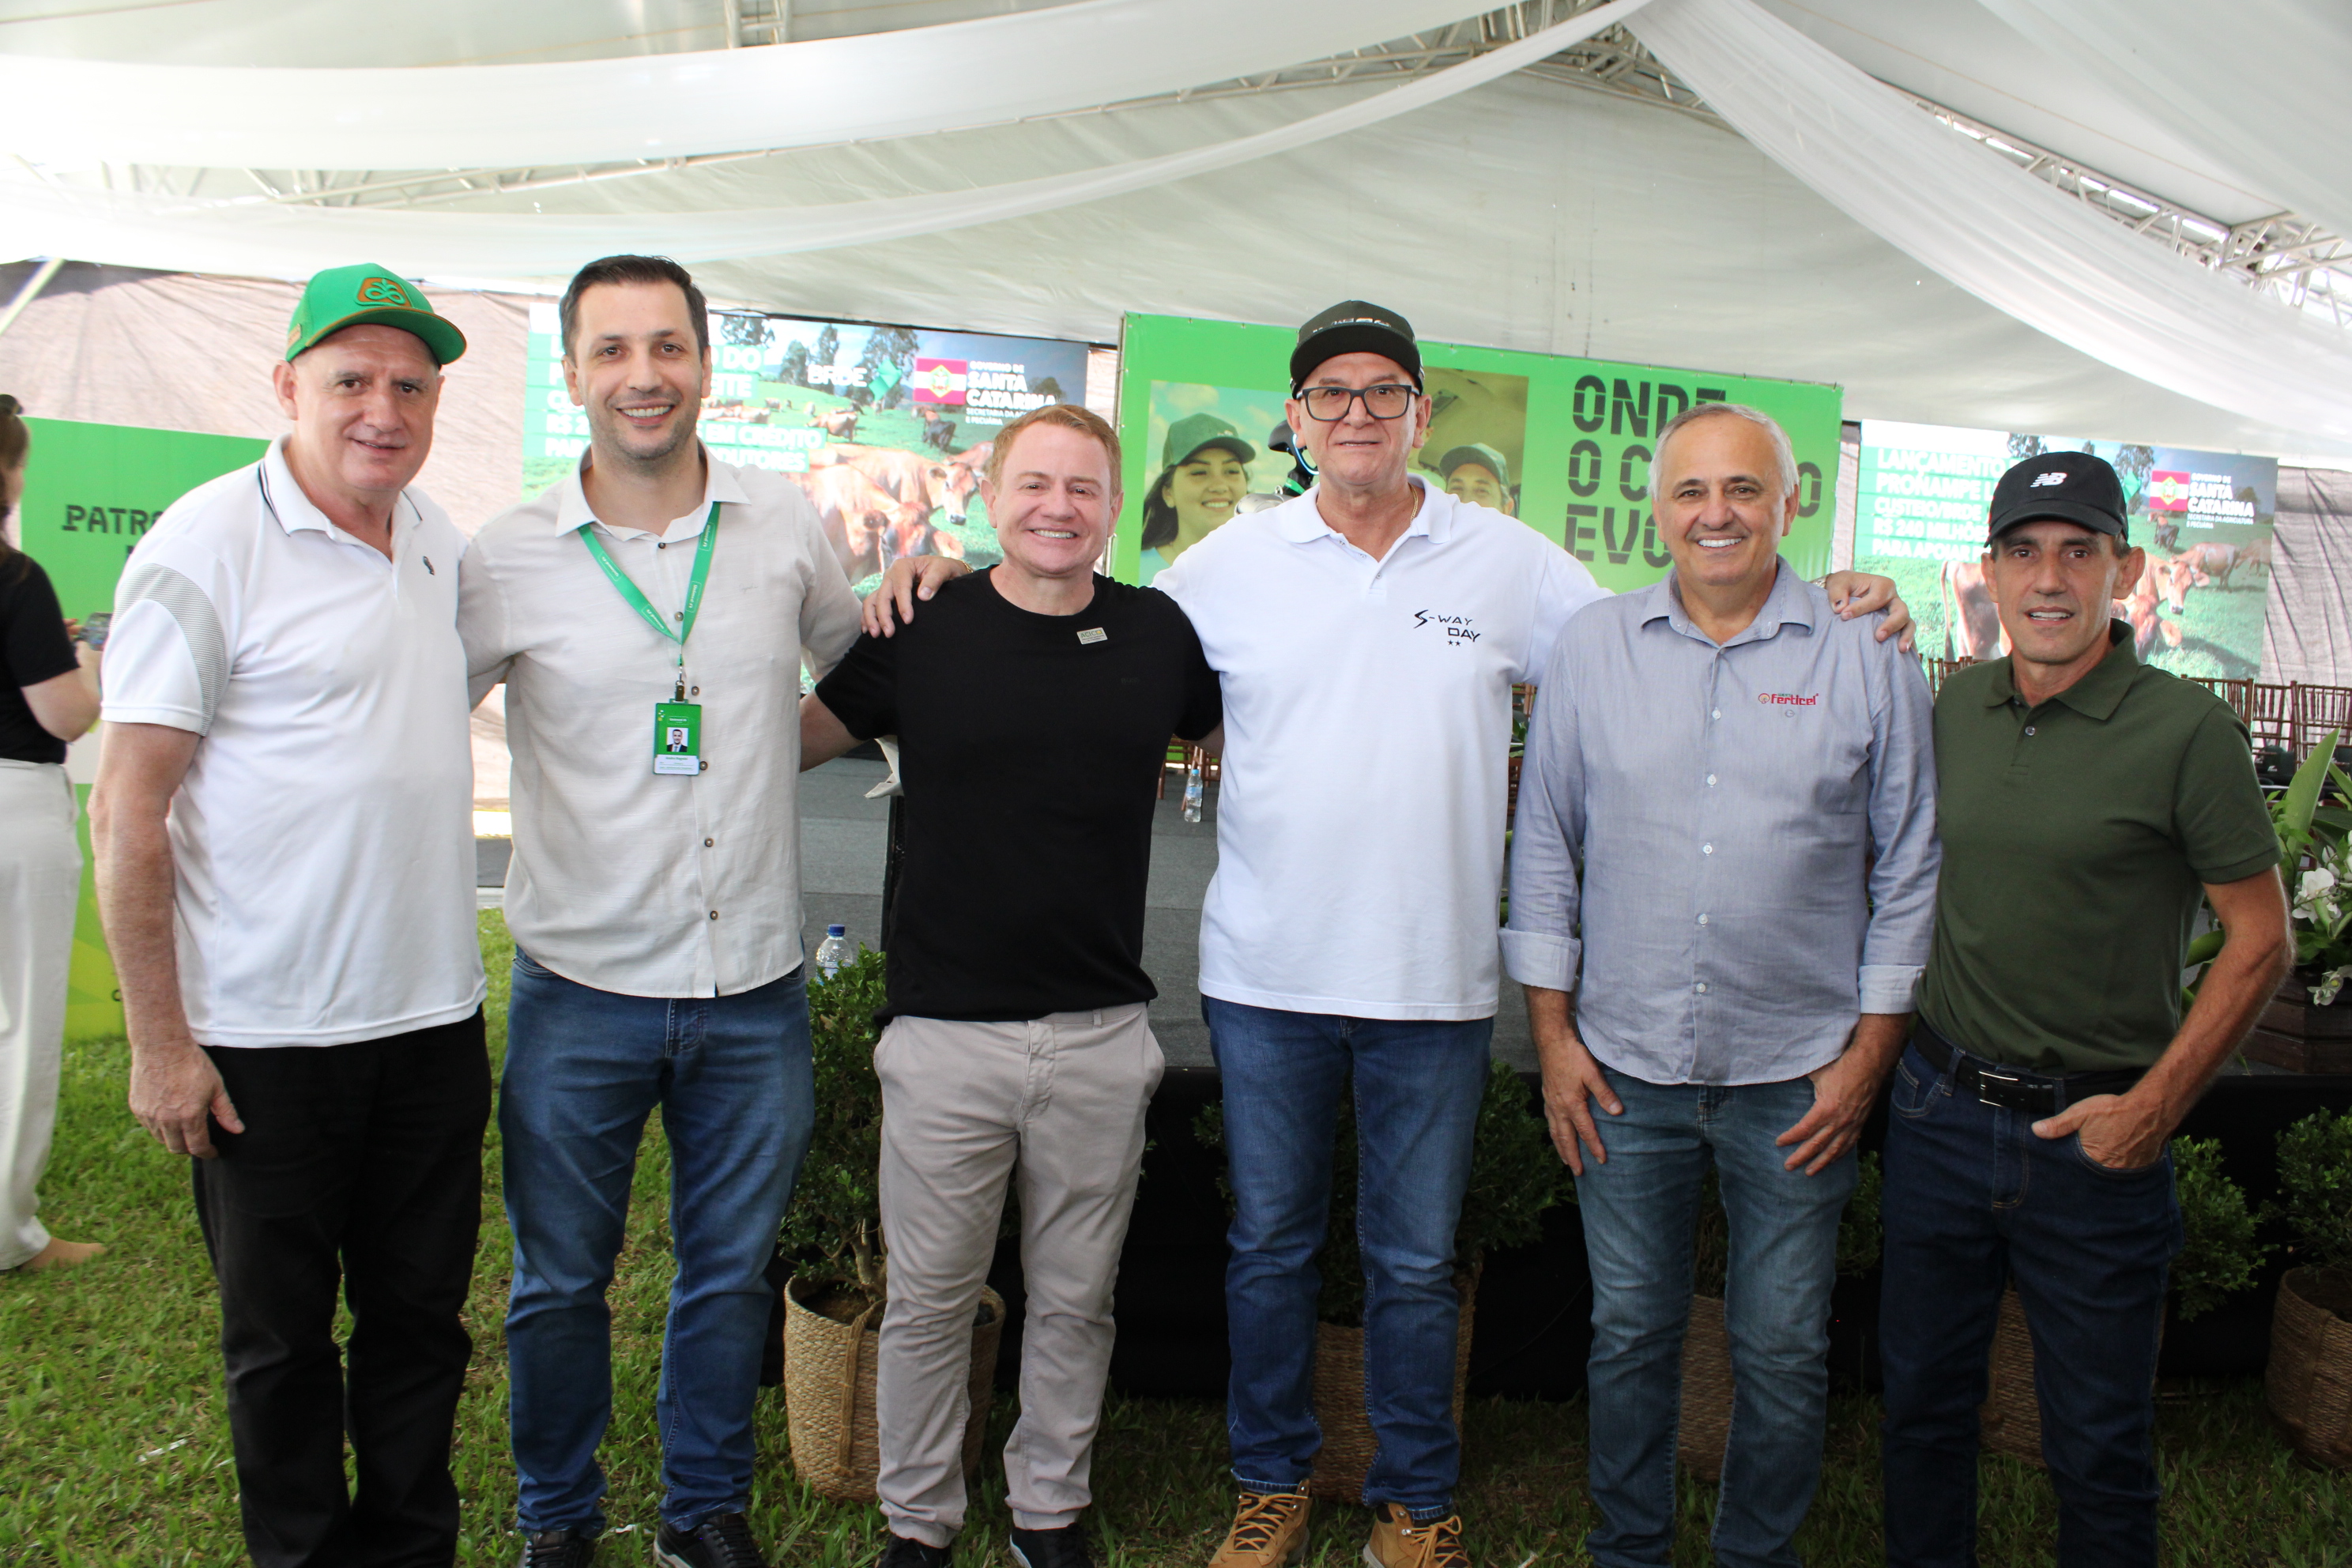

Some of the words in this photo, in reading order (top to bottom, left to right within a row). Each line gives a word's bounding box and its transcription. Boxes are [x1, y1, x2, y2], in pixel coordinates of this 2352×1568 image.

[722, 346, 762, 371] DO
[970, 360, 1012, 373] GOVERNO
[1012, 364, 1025, 374] DE
[807, 364, 868, 387] BRDE
[967, 371, 1028, 392] SANTA
[966, 388, 1057, 410] CATARINA
[1573, 375, 1727, 439] OND
[706, 423, 736, 443] EM
[739, 423, 823, 449] CRÉDITO
[545, 437, 592, 458] PAR
[1568, 439, 1602, 497] O
[1877, 448, 2006, 478] LANÇAMENTO
[1875, 473, 1982, 501] PRONAMPE
[2191, 473, 2222, 484] GOVERNO
[2222, 476, 2231, 484] DE
[2189, 481, 2233, 499] SANTA
[2188, 497, 2255, 518] CATARINA
[1874, 517, 1894, 537] R$
[1896, 520, 1925, 538] 240
[1872, 538, 1912, 557] PARA
[1913, 541, 1970, 561] APOIAR
[1447, 627, 1481, 643] DAY
